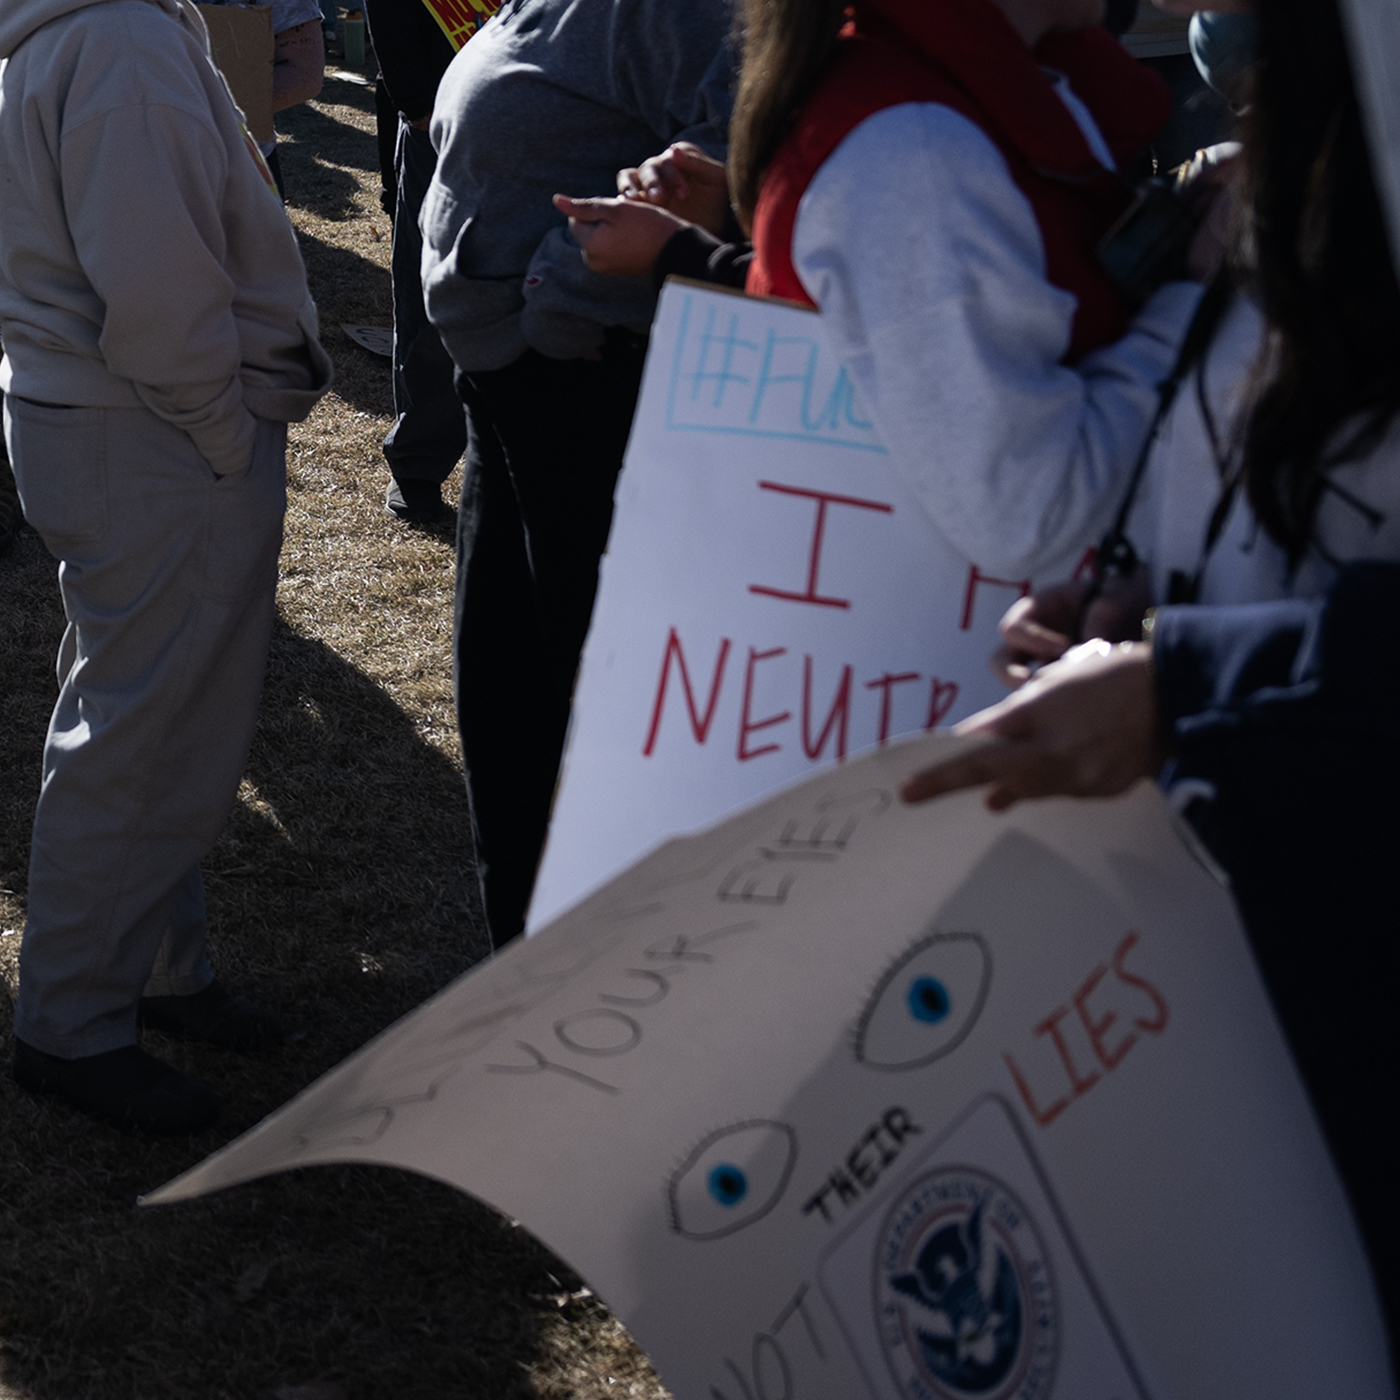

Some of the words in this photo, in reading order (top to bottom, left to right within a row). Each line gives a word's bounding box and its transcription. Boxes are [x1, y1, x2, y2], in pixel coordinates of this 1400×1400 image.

[747, 480, 894, 610] I
[1002, 929, 1169, 1128] LIES
[803, 1105, 923, 1224] THEIR
